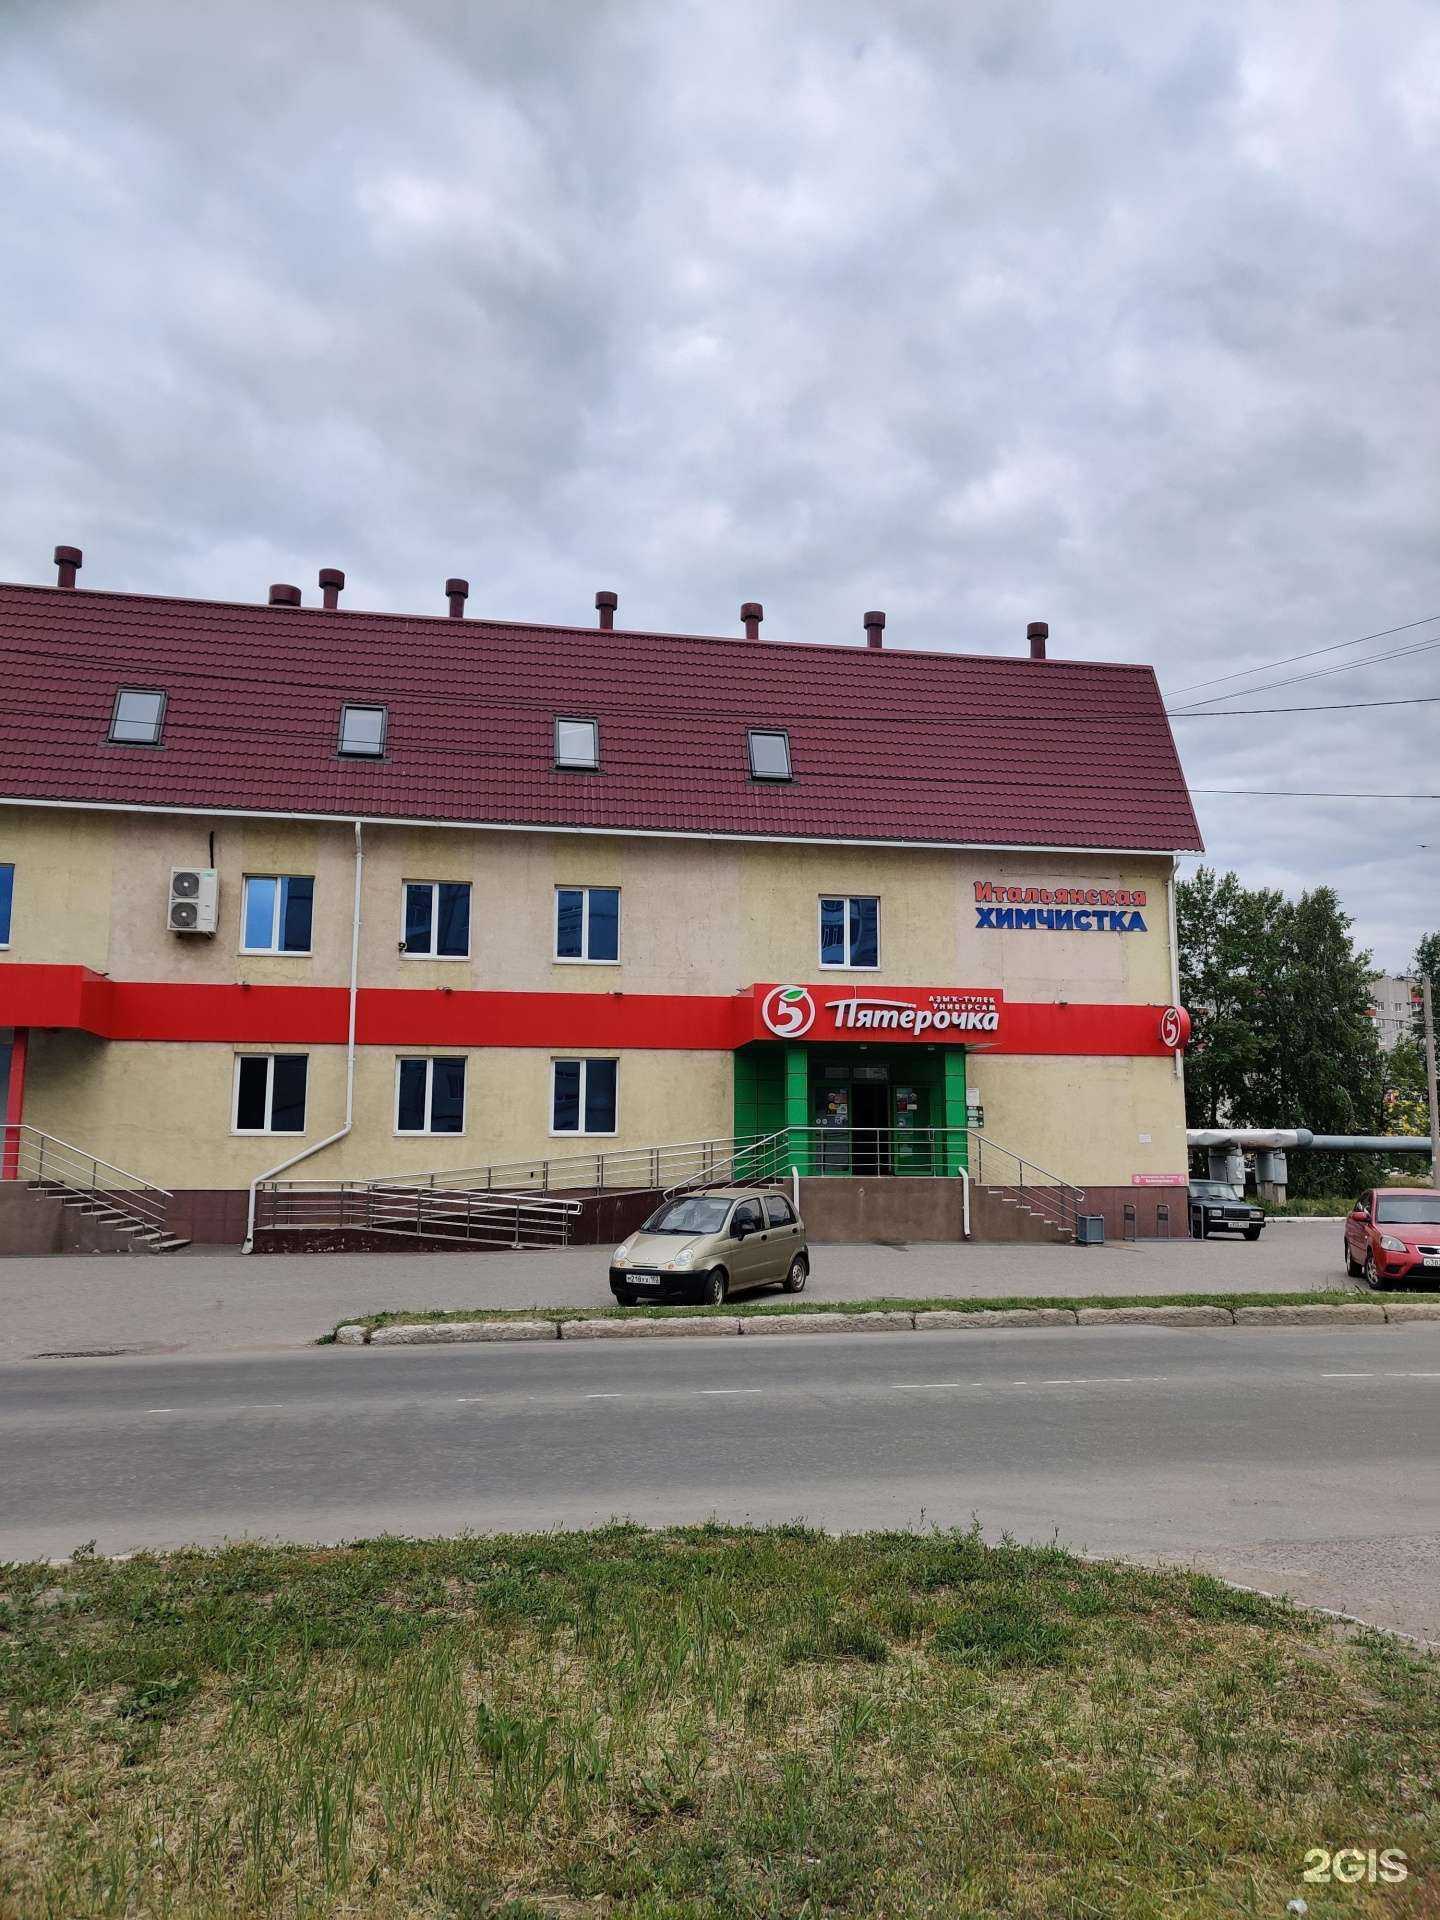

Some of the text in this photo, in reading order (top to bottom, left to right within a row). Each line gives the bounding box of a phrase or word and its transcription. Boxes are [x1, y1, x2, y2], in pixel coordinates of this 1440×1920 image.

[974, 881, 1147, 906] Итальянская
[975, 907, 1148, 932] ХИМЧИСТКА
[933, 1003, 996, 1011] УНИВЕРСАМ
